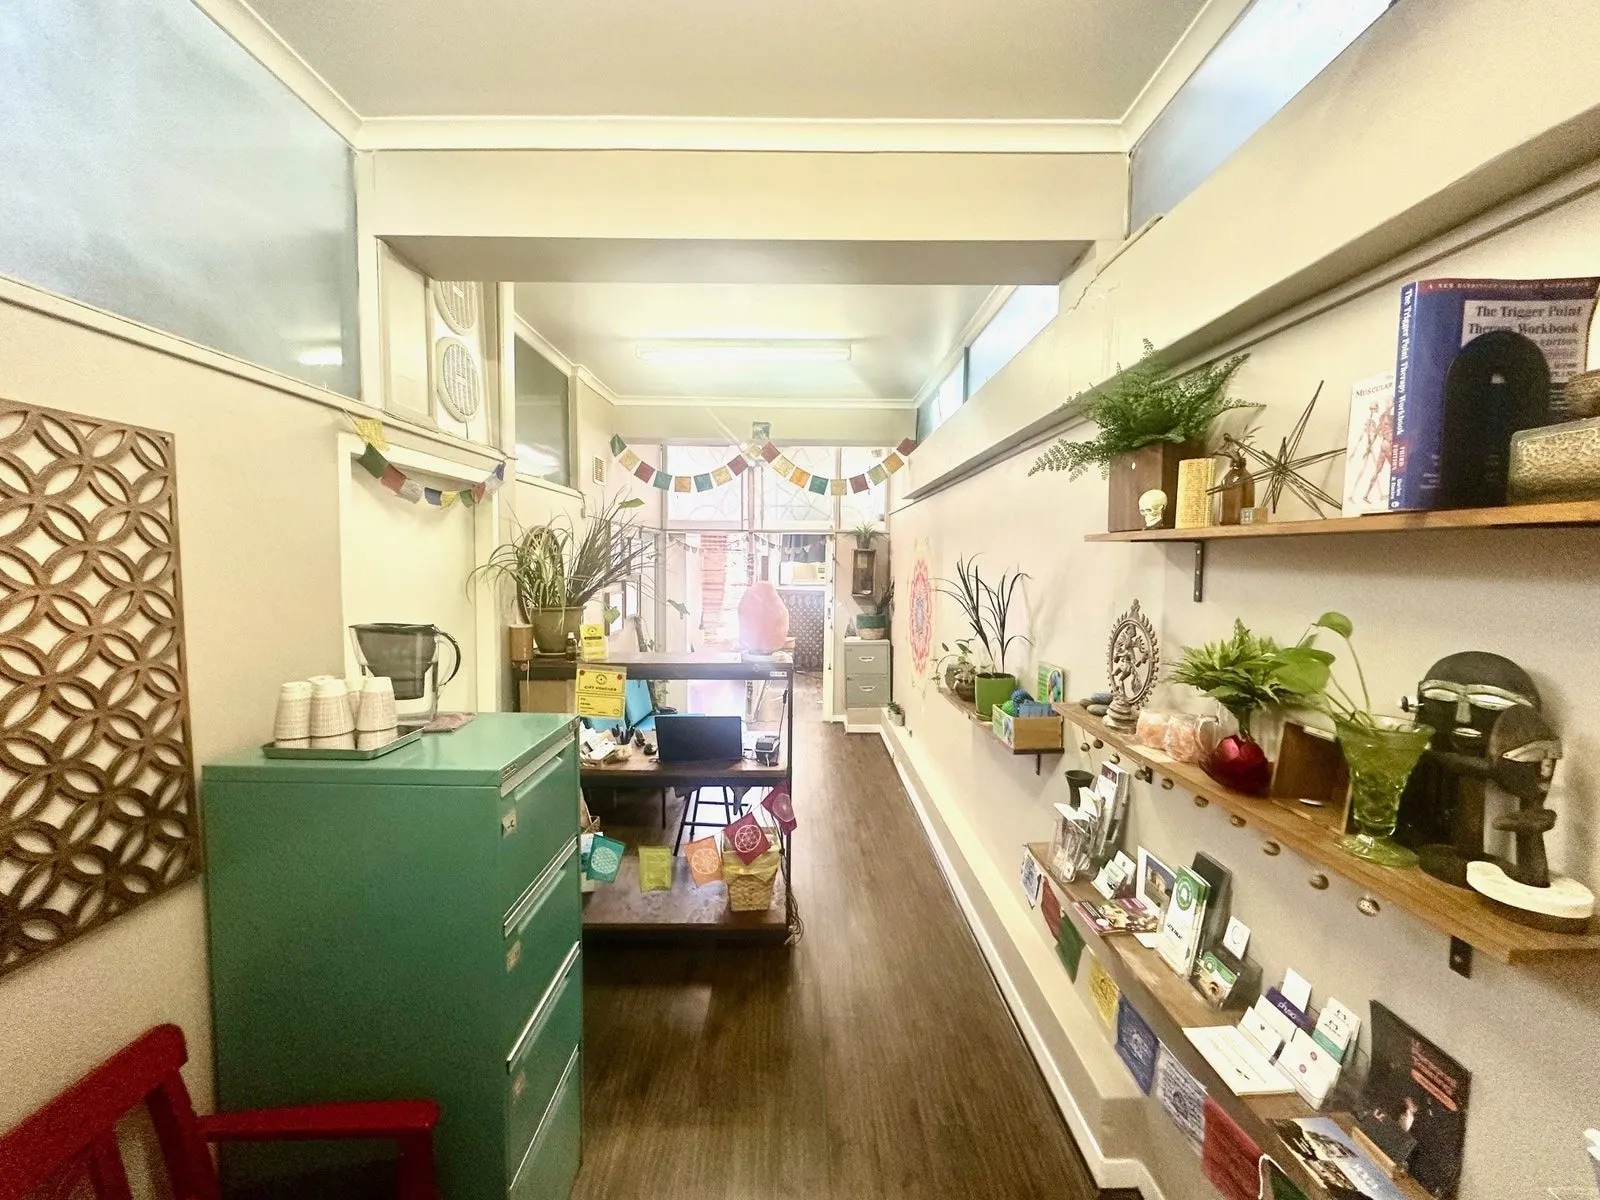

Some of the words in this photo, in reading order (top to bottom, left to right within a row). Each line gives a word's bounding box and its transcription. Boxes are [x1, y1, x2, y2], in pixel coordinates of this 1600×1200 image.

[1404, 288, 1412, 305] The
[1402, 306, 1412, 337] Trigger
[1476, 306, 1497, 317] The
[1502, 305, 1544, 319] Trigger
[1548, 304, 1582, 317] Point
[1518, 323, 1578, 334] Workbook
[1401, 338, 1409, 360] Point
[1398, 361, 1408, 393] Therapy
[1397, 395, 1406, 436] Workbook
